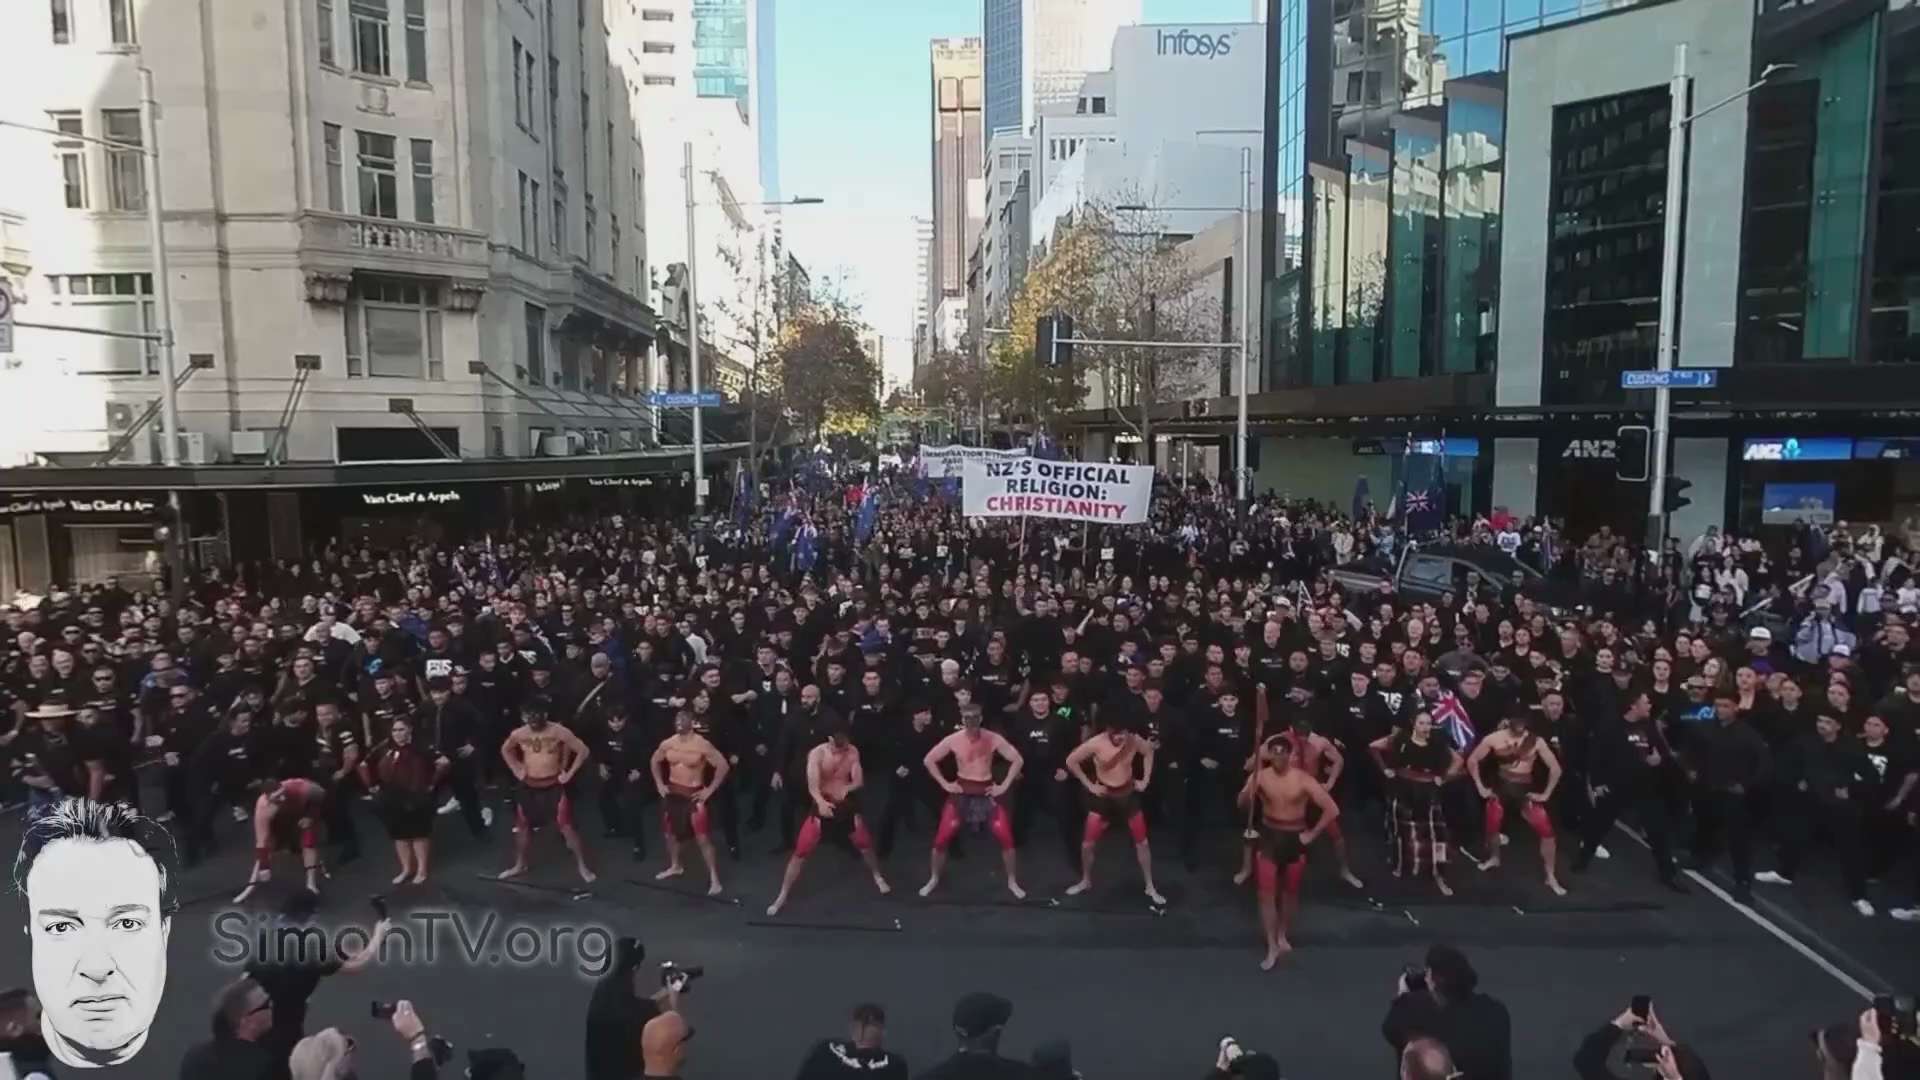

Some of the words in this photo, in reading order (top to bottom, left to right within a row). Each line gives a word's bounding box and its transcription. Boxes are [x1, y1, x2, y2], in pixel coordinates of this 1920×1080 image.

[1157, 28, 1231, 60] Infosys
[1626, 373, 1670, 385] CUSTOMS
[1561, 439, 1617, 458] ANZ
[1743, 443, 1784, 460] ANZ
[986, 460, 1033, 478] NZ'S
[1037, 463, 1130, 485] OFFICIAL
[363, 493, 385, 504] Van
[386, 491, 416, 504] Cleef
[427, 490, 460, 504] Arpels
[1006, 478, 1107, 500] RELIGION:
[69, 500, 92, 511] Van
[93, 500, 123, 511] Cleef
[986, 496, 1127, 519] CHRISTIANITY
